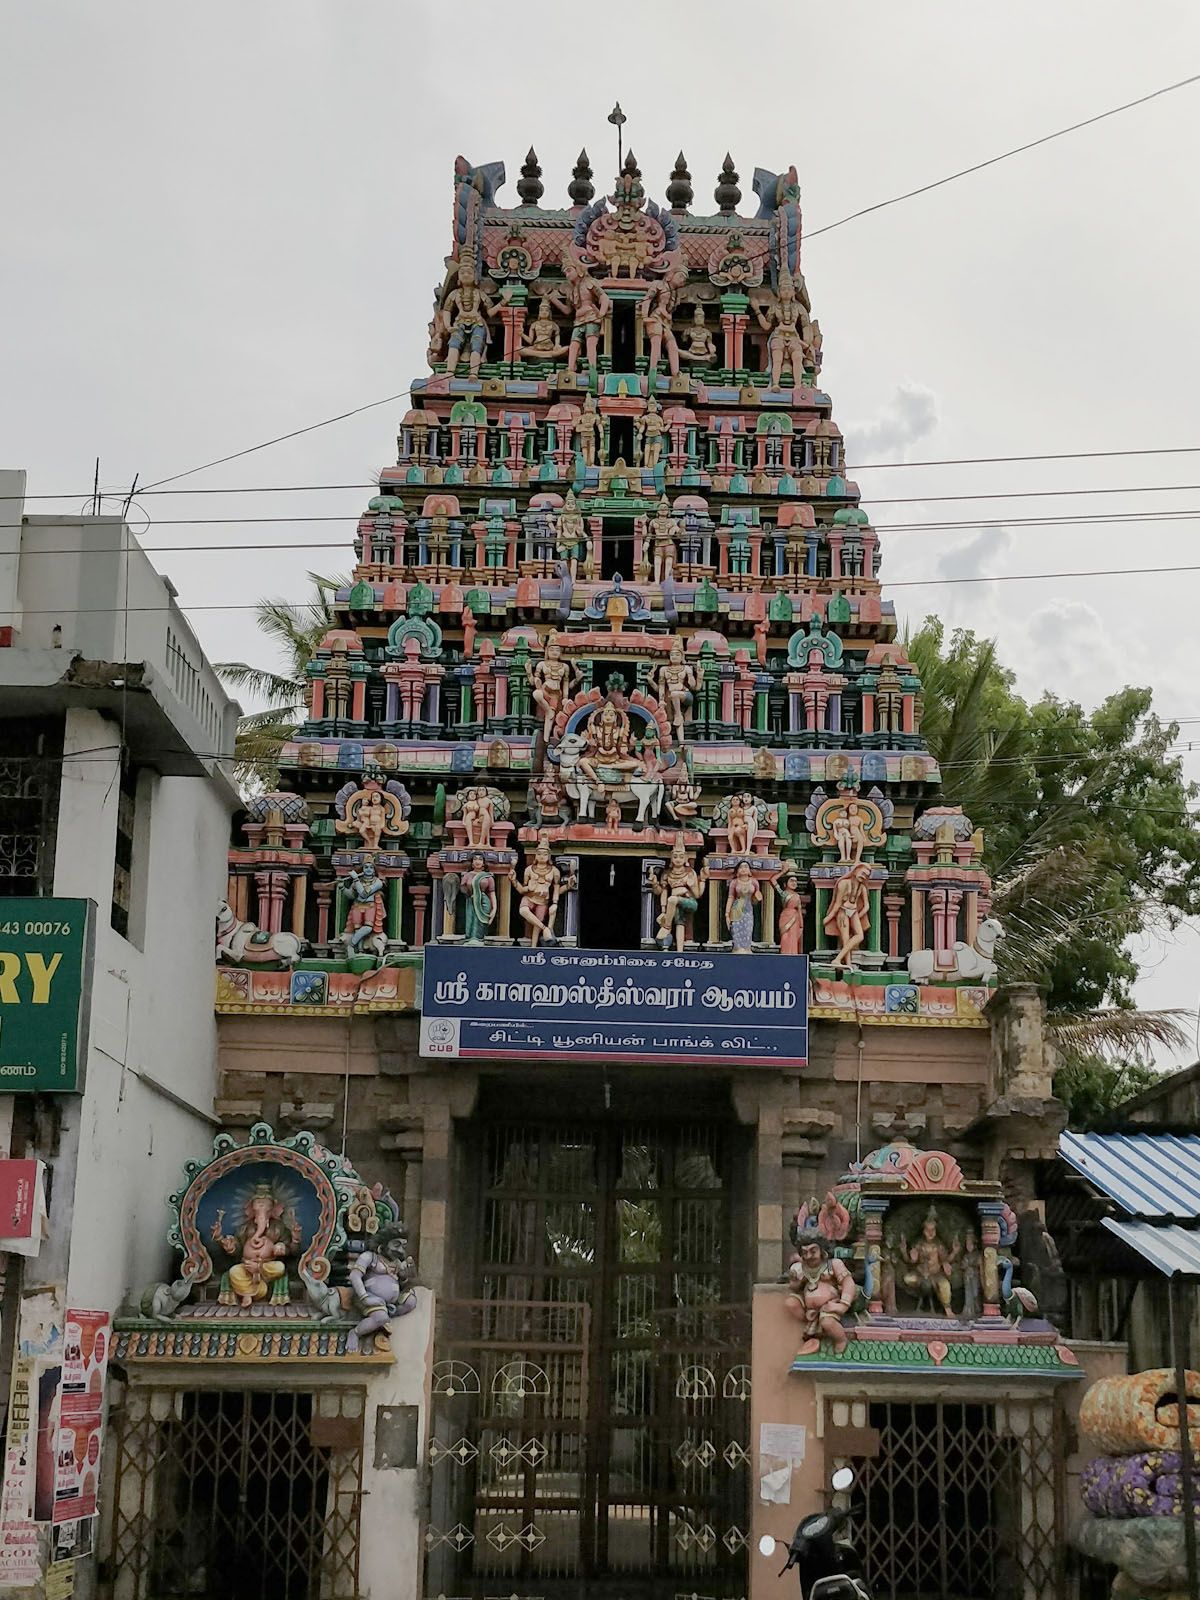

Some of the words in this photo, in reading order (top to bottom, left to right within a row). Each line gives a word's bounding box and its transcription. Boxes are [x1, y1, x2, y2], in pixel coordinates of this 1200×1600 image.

[25, 922, 71, 935] 00076
[661, 957, 714, 970] சமேத
[475, 975, 695, 1010] காளஹஸ்தீஸ்வரர்
[701, 981, 796, 1012] ஆலயம்
[489, 1030, 545, 1046] சிட்டி
[552, 1033, 645, 1049] யூனியன்
[653, 1035, 714, 1049] பாங்க்
[429, 1044, 453, 1052] CUB
